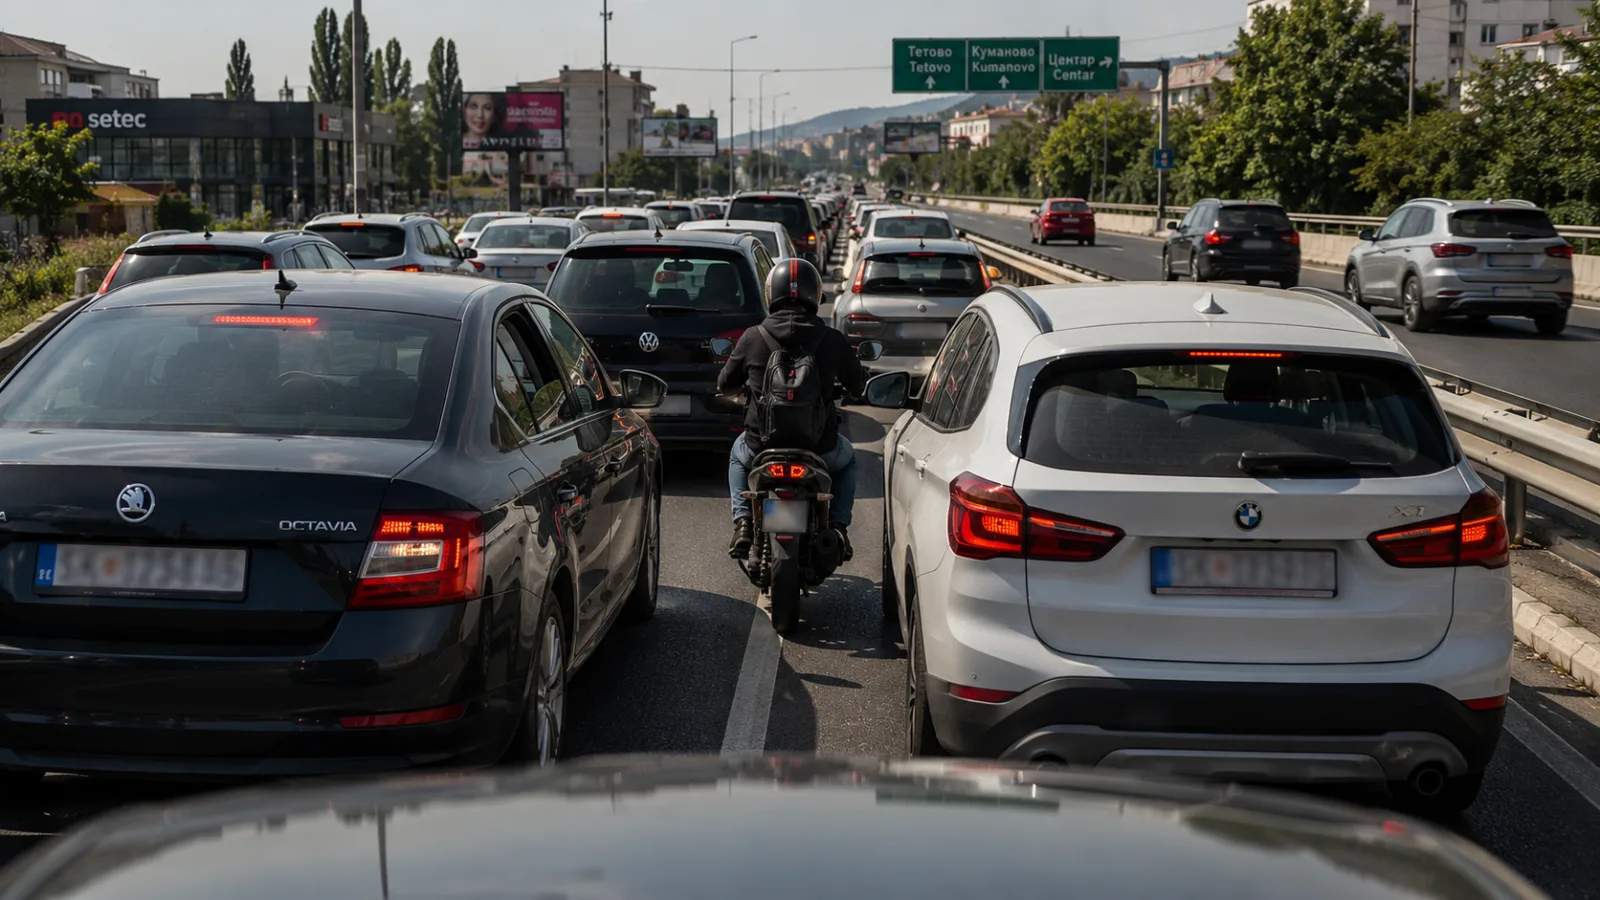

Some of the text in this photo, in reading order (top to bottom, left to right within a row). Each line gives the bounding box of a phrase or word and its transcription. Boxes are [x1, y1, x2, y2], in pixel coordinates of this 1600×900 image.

[908, 46, 952, 57] Тетово
[972, 46, 1035, 59] Куманово
[1049, 54, 1095, 66] Центар
[910, 61, 951, 72] Tetovo
[972, 62, 1035, 72] Kumanovo
[1054, 69, 1095, 80] Centar
[88, 109, 146, 128] setec
[1388, 505, 1427, 518] X1
[279, 520, 357, 532] OCTAVIA
